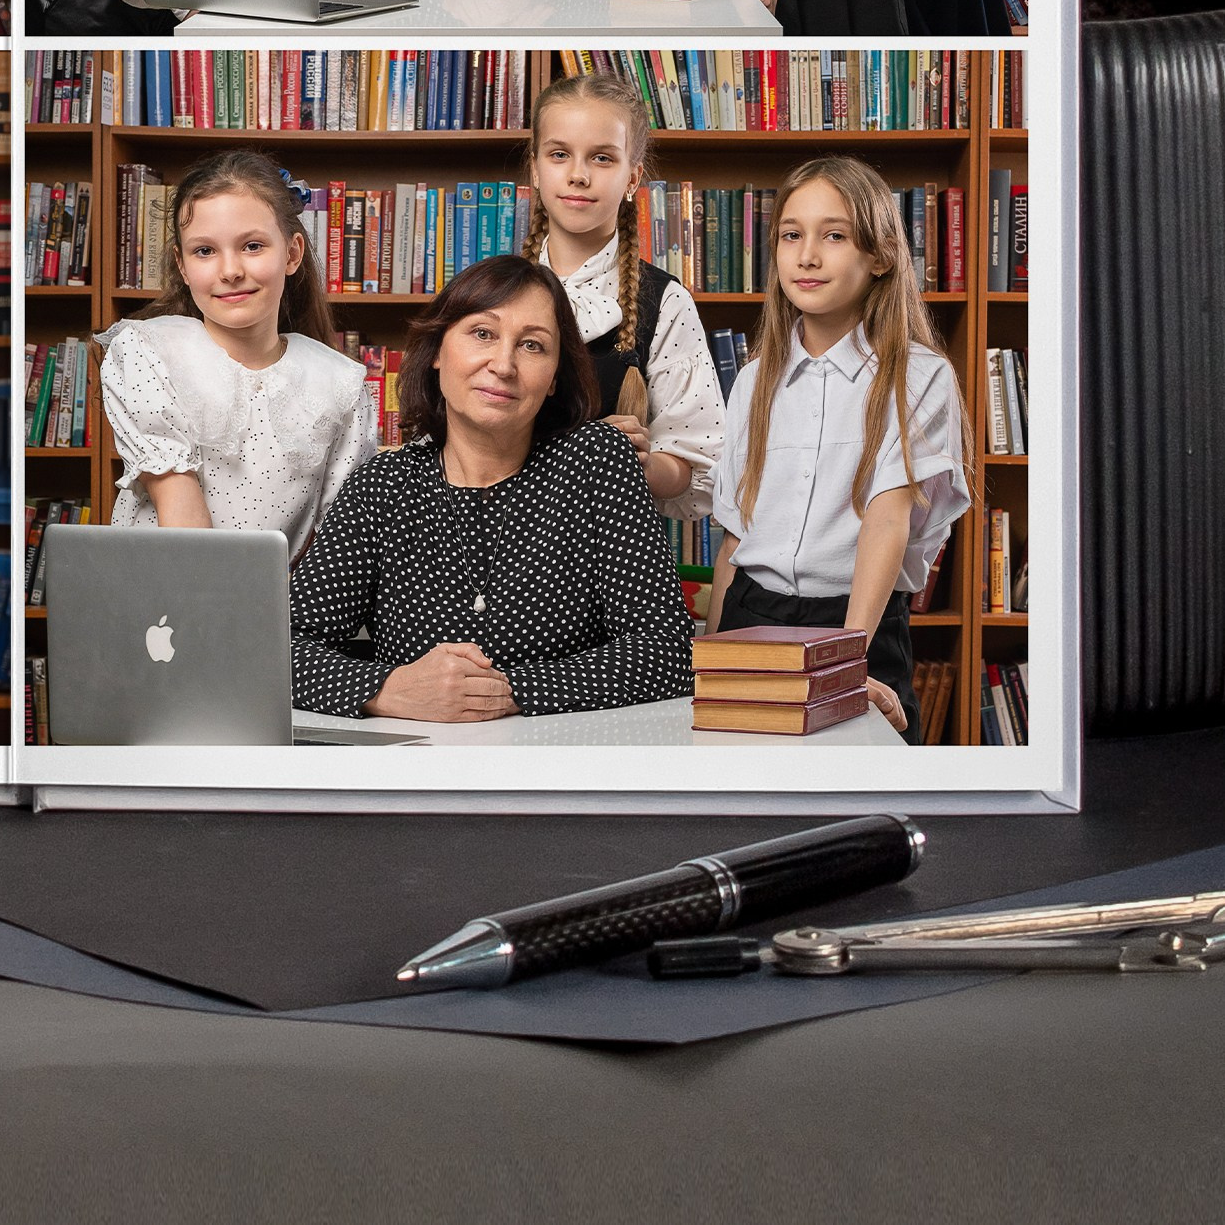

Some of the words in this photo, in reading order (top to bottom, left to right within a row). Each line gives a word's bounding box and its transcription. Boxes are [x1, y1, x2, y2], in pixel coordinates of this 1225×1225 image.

[284, 72, 295, 95] России
[305, 55, 315, 98] РОССИИ
[283, 95, 297, 123] История
[840, 81, 848, 115] СОФИЯ
[352, 201, 362, 230] РОССИИ
[1014, 196, 1027, 254] СТАЛИН
[147, 244, 157, 279] ИСТОРИЯ
[329, 228, 342, 282] ЭНЦИКЛОПЕДИЯ
[370, 230, 378, 263] РОССИИ
[382, 232, 392, 270] ИСТОРИЯ
[381, 273, 390, 289] ВСЯ
[62, 375, 71, 406] ПАРИЖ
